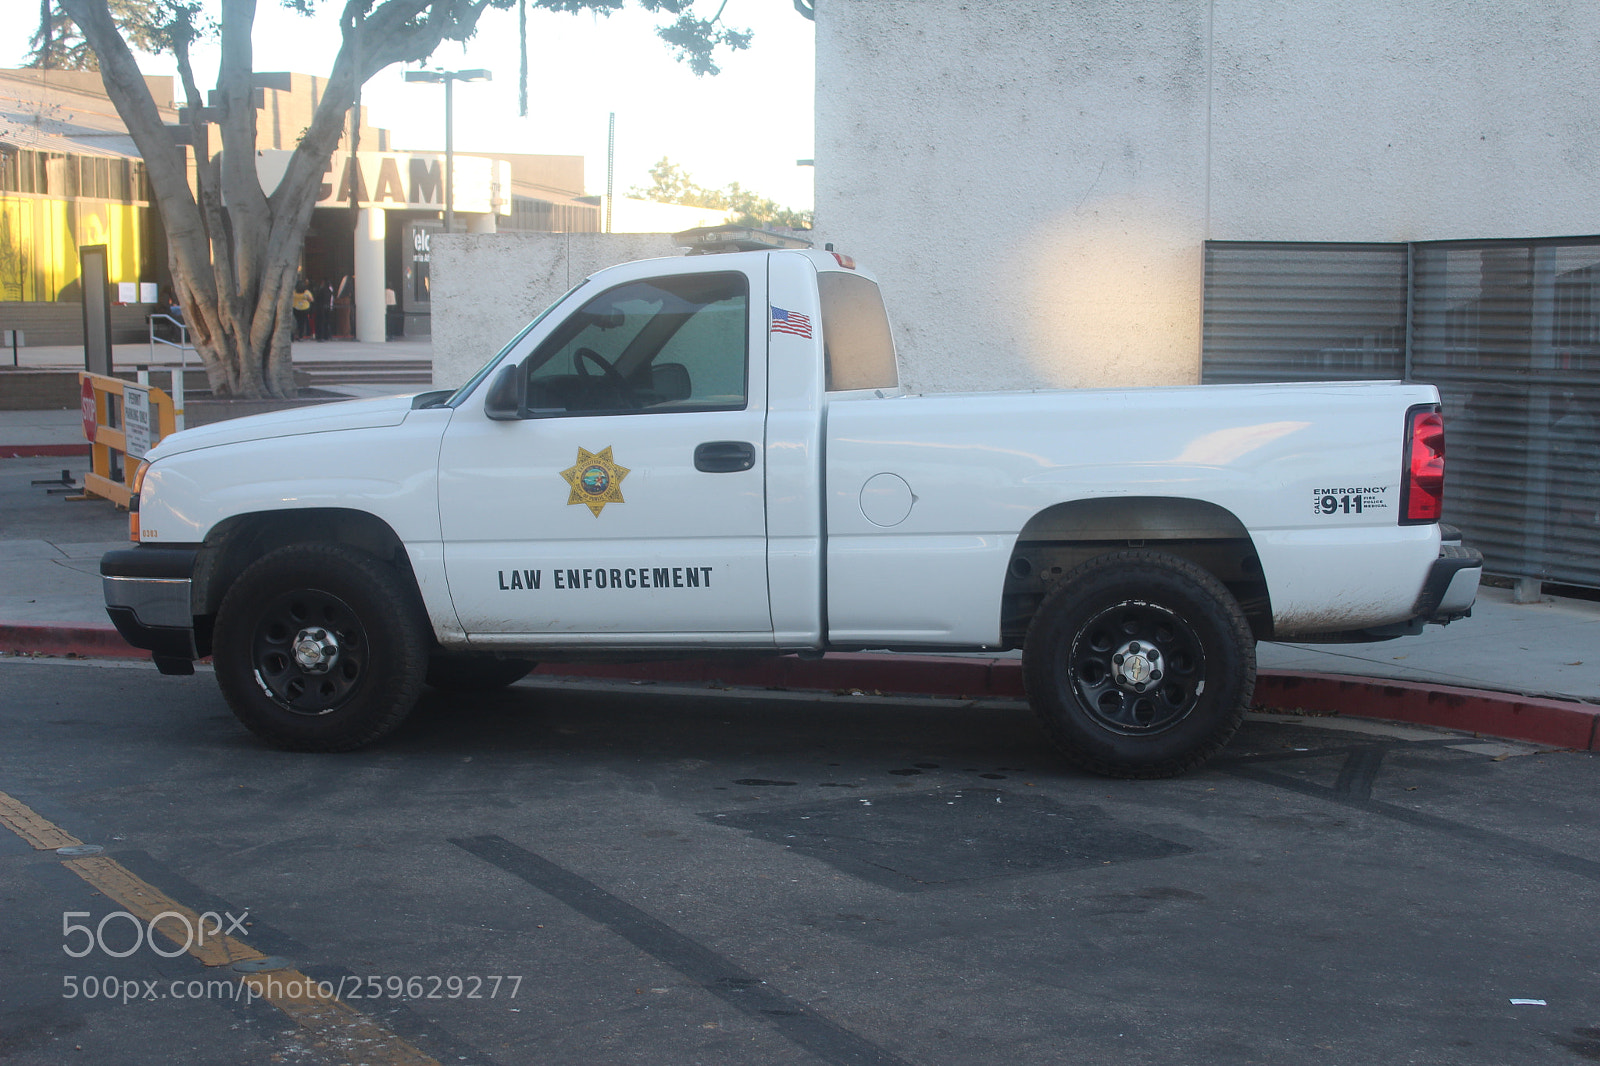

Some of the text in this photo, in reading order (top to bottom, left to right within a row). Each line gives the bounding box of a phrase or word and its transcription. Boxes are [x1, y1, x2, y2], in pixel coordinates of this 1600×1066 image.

[82, 397, 95, 421] STOP
[1313, 487, 1387, 495] EMERGENCY
[1321, 495, 1362, 514] 9-1-1
[498, 567, 713, 591] LAW ENFORCEMENT
